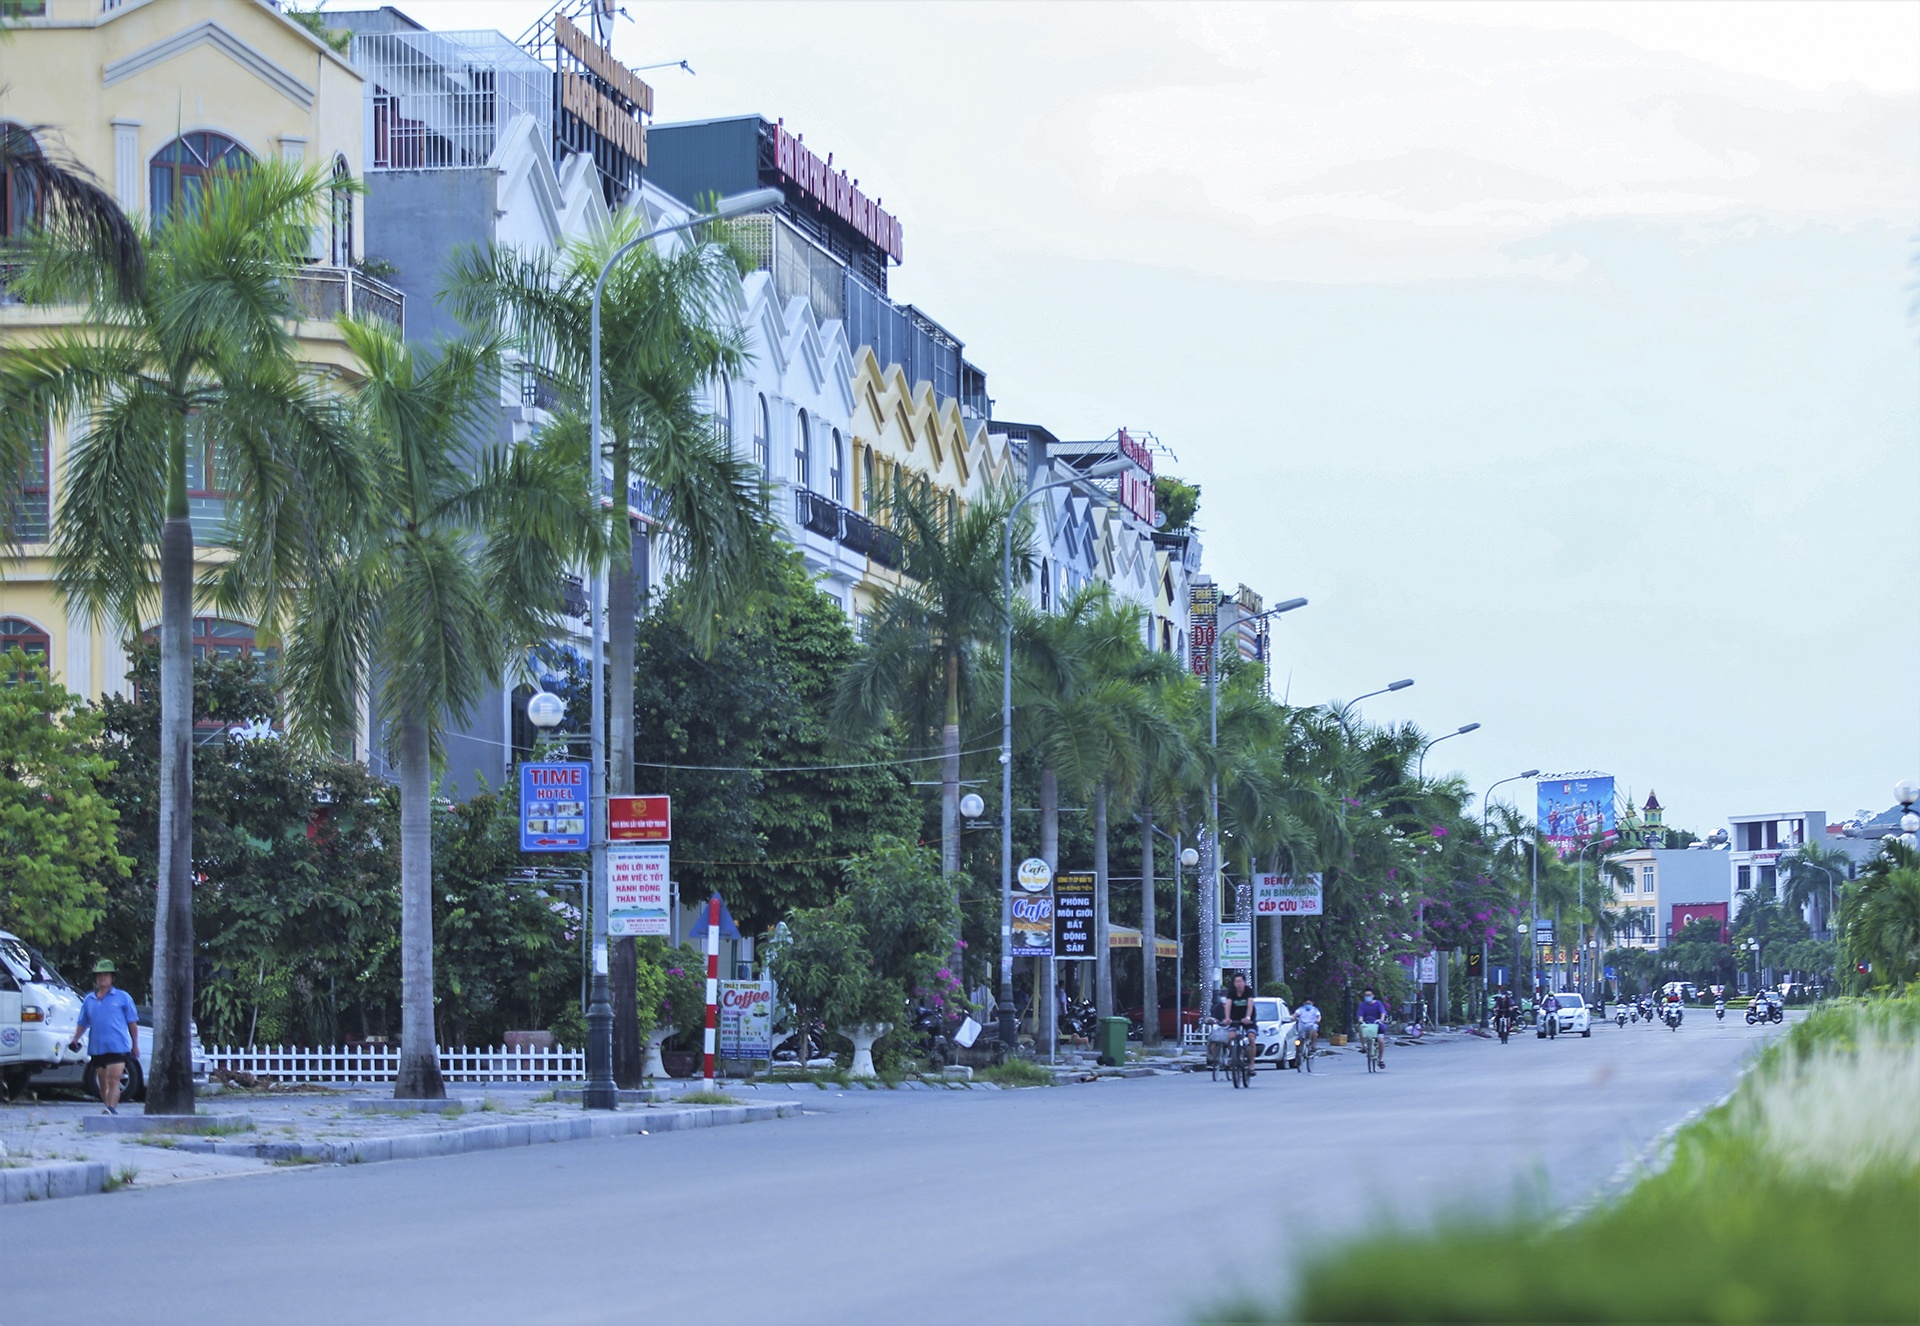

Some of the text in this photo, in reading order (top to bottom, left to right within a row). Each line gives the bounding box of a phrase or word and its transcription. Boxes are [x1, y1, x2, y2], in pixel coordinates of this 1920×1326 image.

[530, 769, 582, 786] TIME
[537, 788, 574, 800] HOTEL
[616, 862, 660, 871] NÓI LỜI HAY
[1022, 862, 1048, 876] Café
[612, 872, 664, 882] LÀM VIỆC TỐT
[616, 883, 661, 893] HÀNH ĐỘNG
[1260, 889, 1271, 897] AN
[616, 894, 661, 903] THÂN THIỆN
[1060, 896, 1090, 906] PHÒNG
[1258, 898, 1276, 911] CẤP
[1278, 898, 1297, 911] CỨU
[1013, 898, 1053, 922] Café
[1057, 908, 1093, 917] MÔI GIỚI
[1066, 919, 1083, 929] BẤT
[1063, 931, 1087, 942] ĐỘNG
[1066, 941, 1084, 952] SẢN
[723, 990, 771, 1009] Coffee
